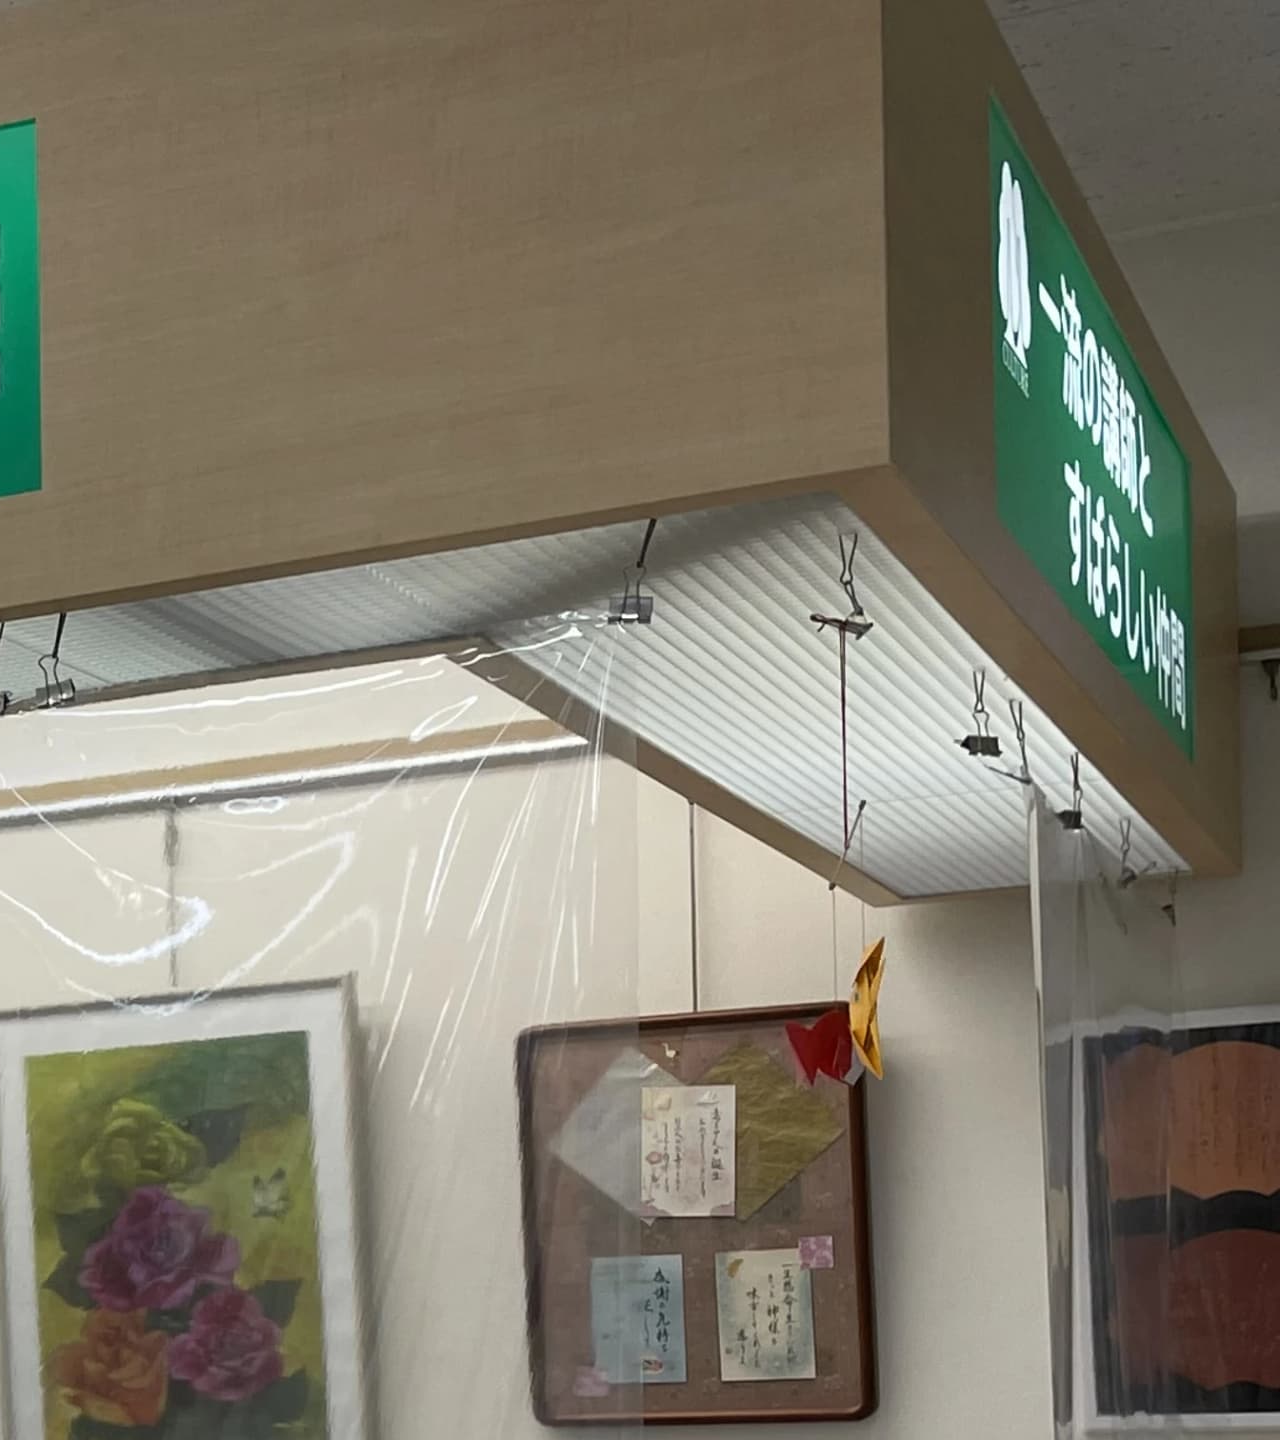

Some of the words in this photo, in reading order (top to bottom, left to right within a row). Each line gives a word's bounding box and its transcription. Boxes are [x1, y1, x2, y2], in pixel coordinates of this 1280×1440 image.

[1039, 274, 1153, 537] 一流の講師と
[1064, 460, 1186, 730] すばらしい仲間
